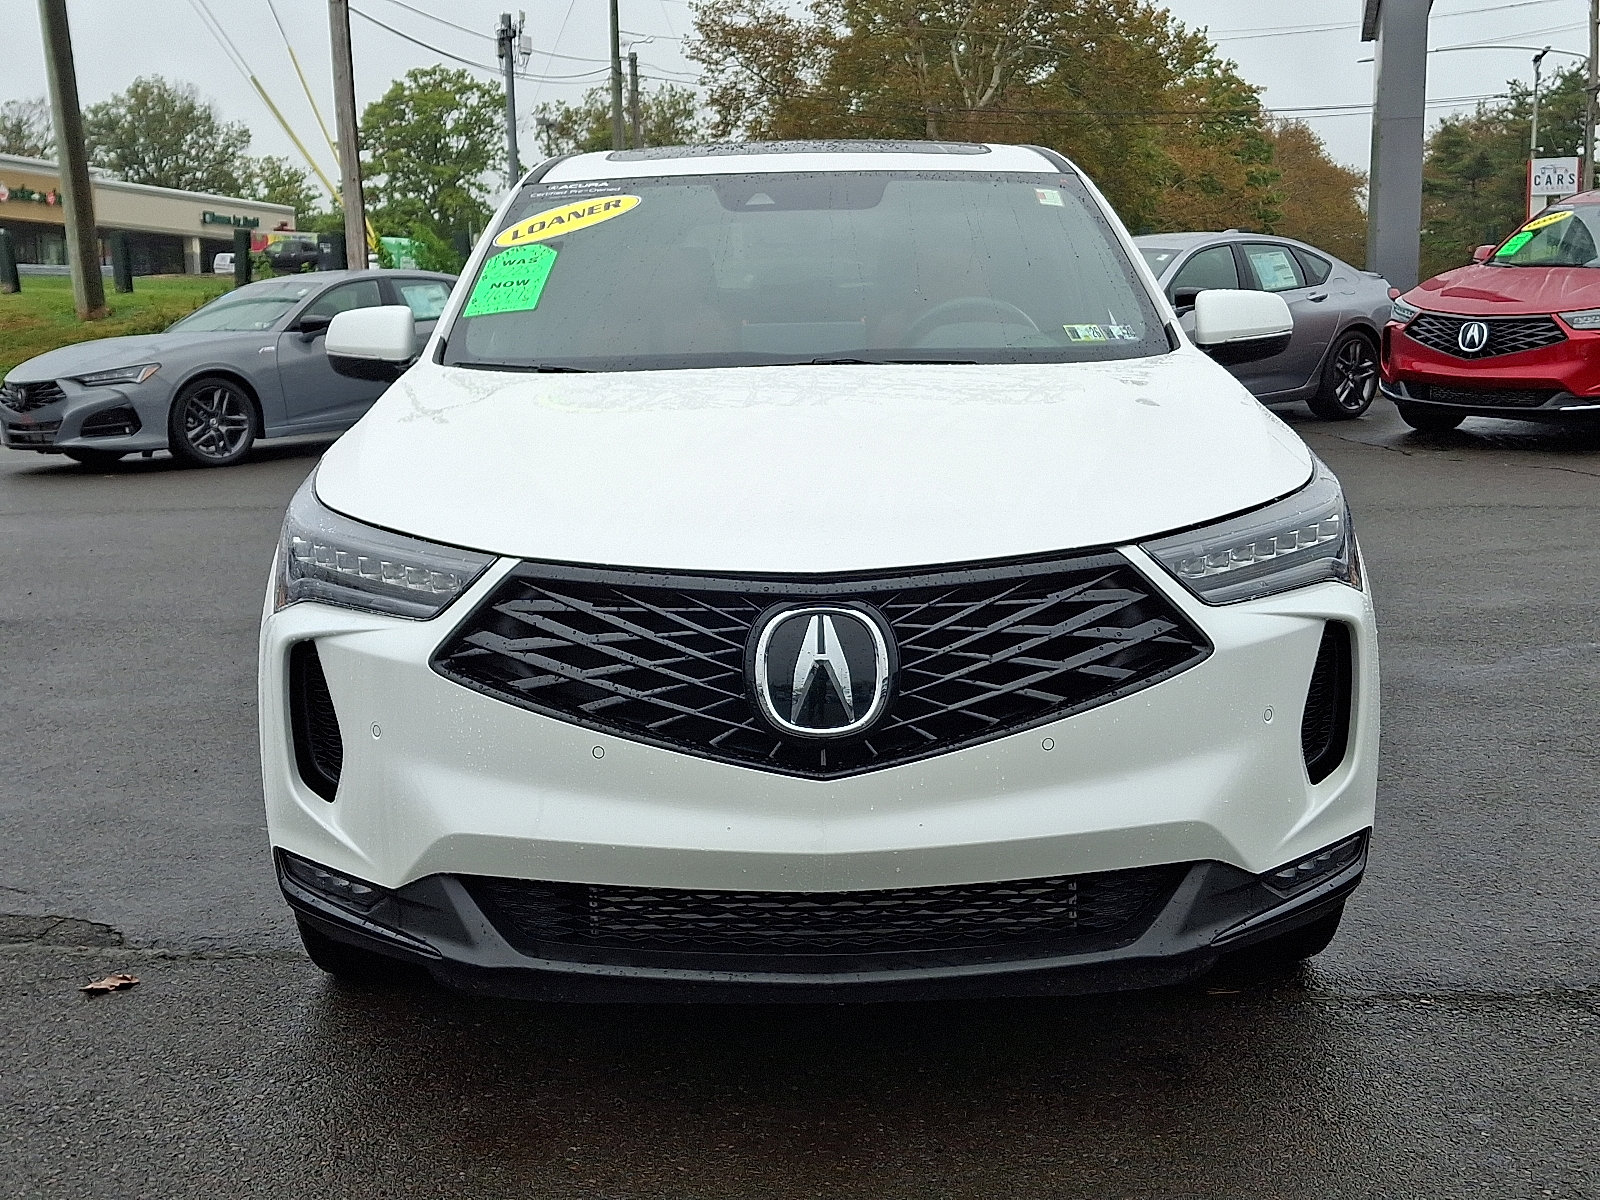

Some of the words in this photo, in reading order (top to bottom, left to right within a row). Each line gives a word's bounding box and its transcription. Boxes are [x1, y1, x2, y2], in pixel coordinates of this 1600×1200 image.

[1534, 173, 1575, 185] CARS
[511, 199, 622, 240] LOANER
[502, 256, 539, 267] WAS
[490, 279, 531, 290] NOW
